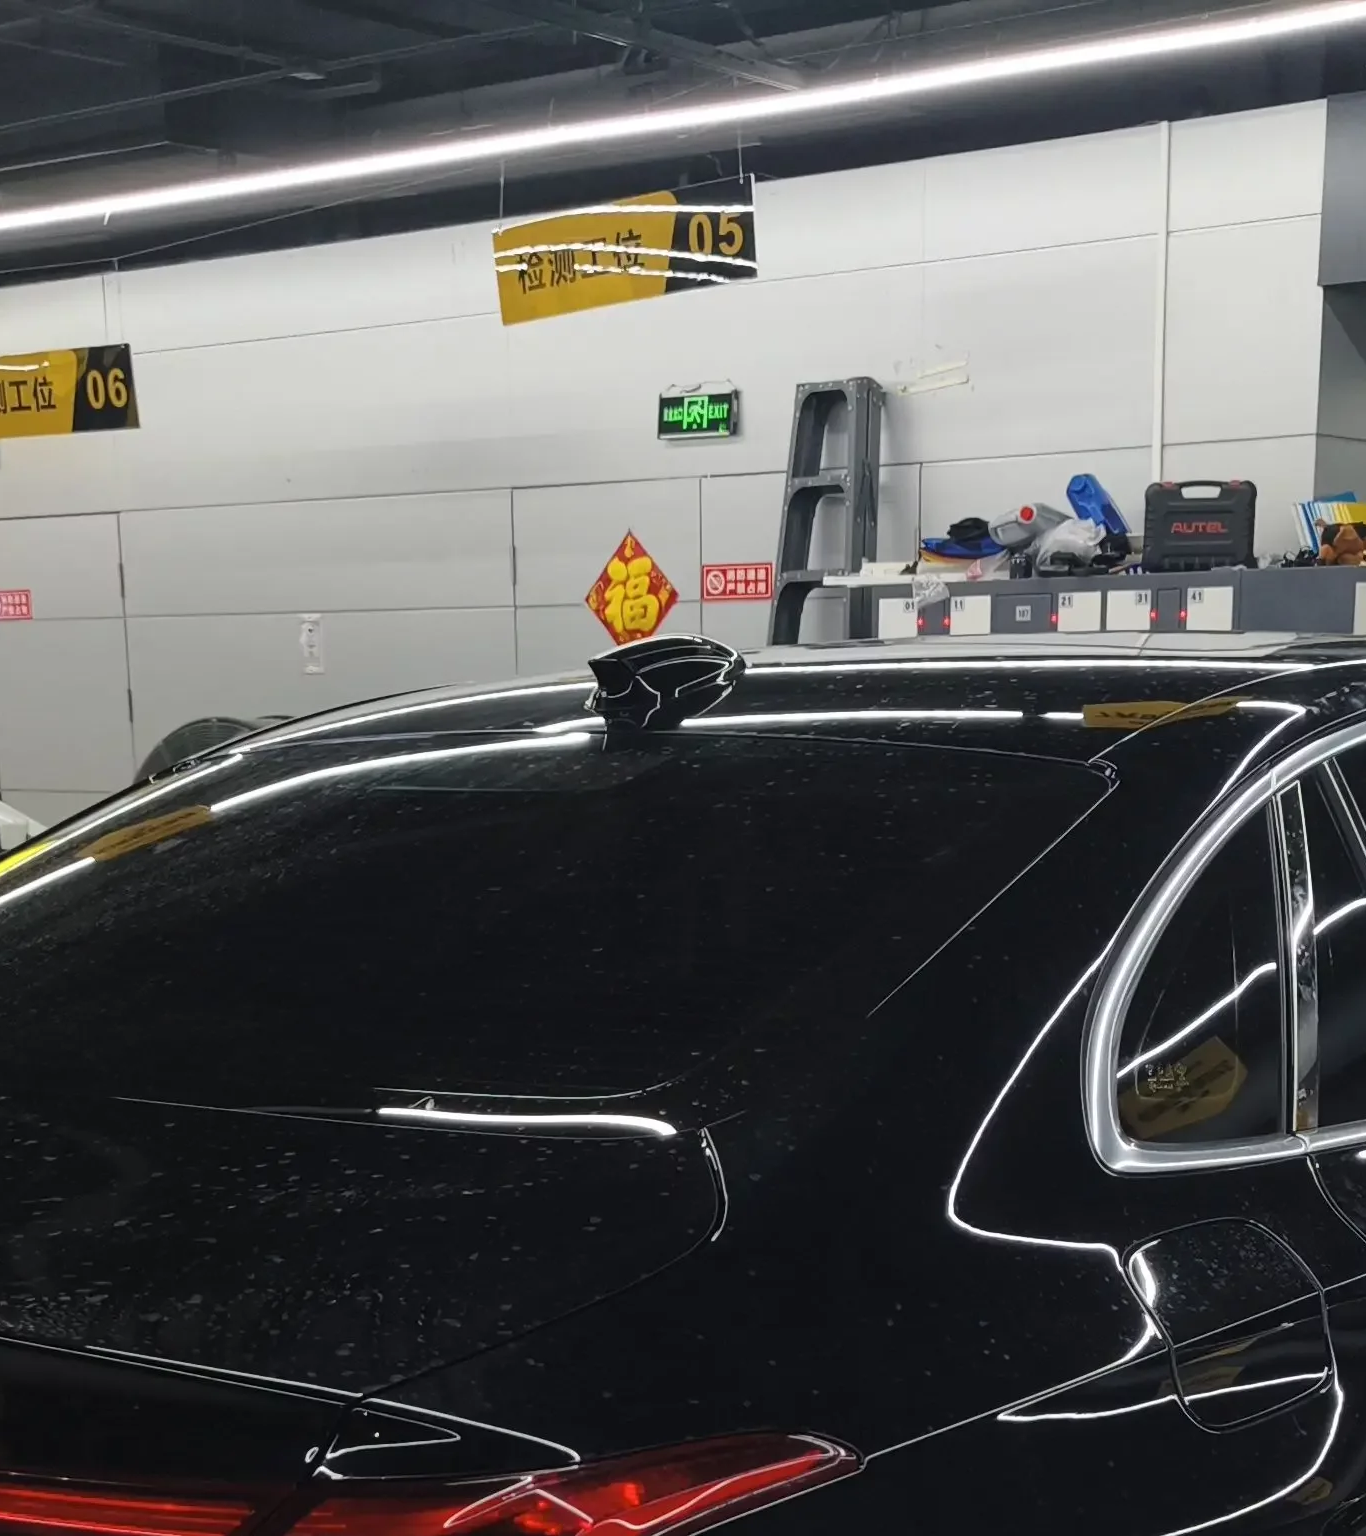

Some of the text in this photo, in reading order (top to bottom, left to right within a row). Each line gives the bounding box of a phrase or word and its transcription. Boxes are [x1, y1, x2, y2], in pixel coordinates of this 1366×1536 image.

[517, 211, 744, 295] 检测工位 05
[86, 368, 128, 410] 06
[1170, 521, 1230, 534] AUTEL
[606, 556, 660, 634] 福
